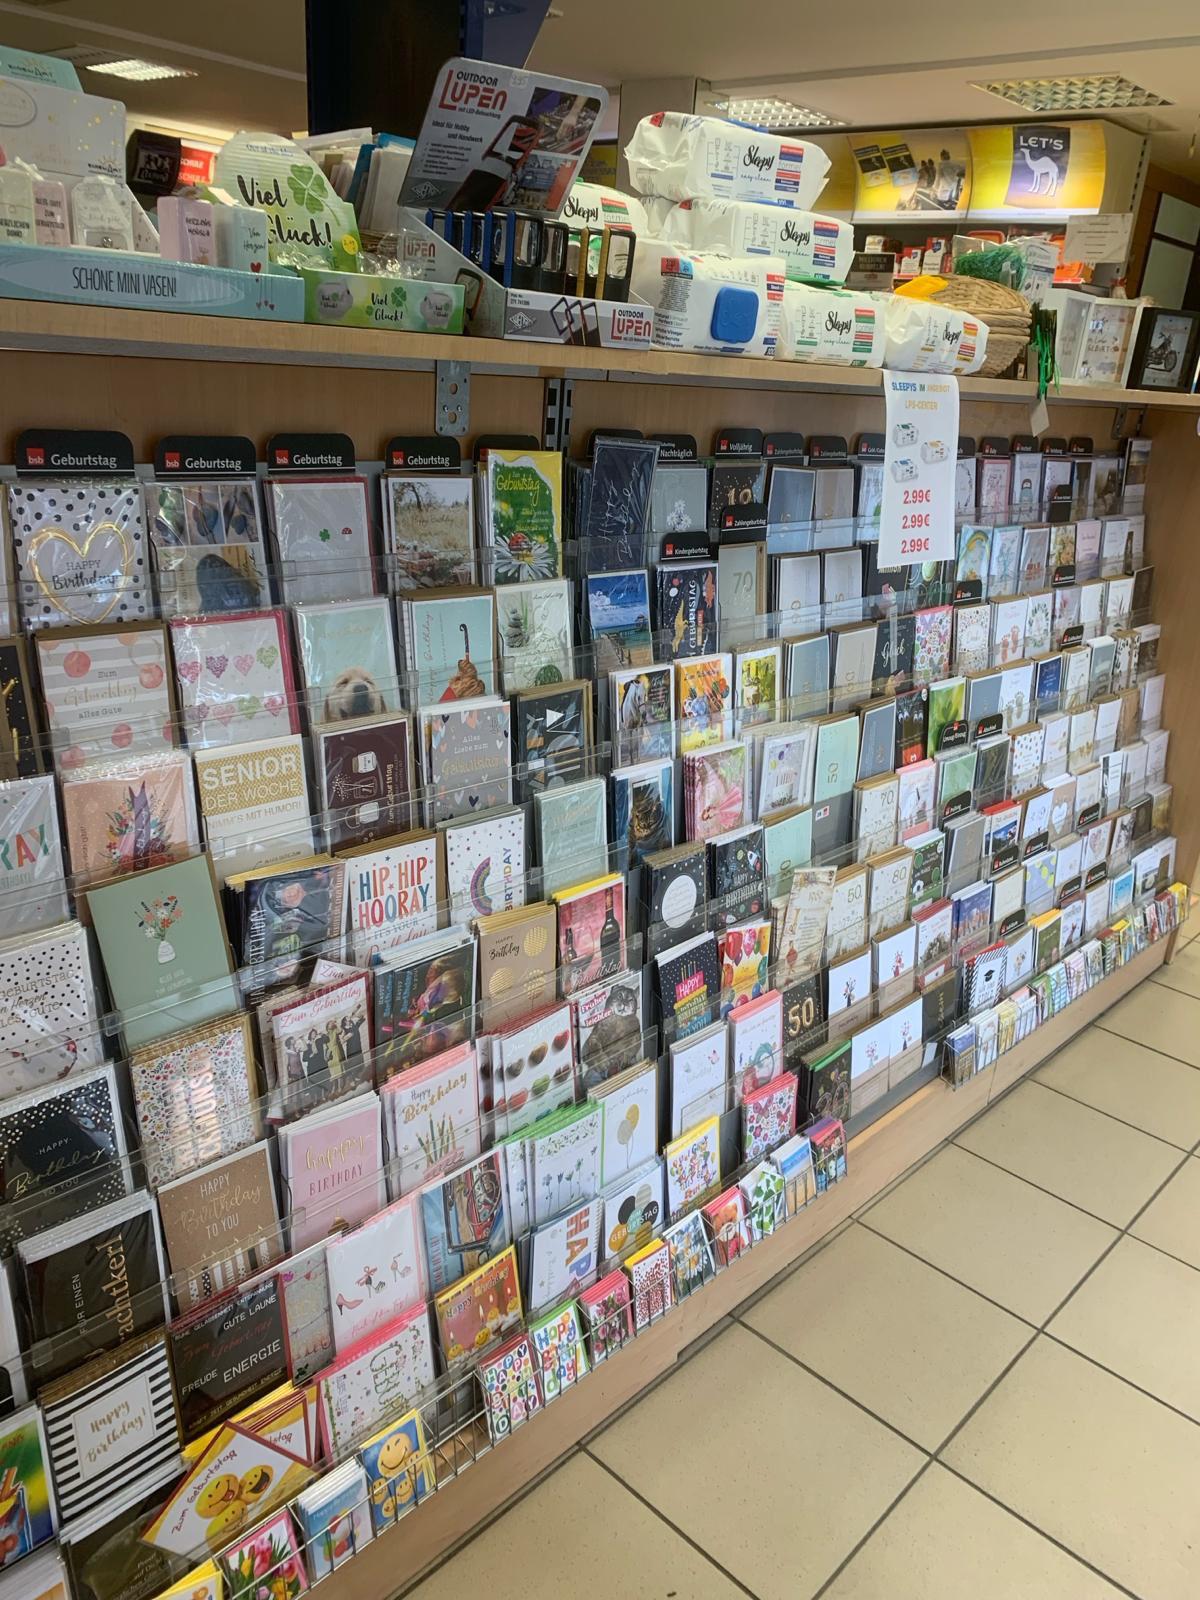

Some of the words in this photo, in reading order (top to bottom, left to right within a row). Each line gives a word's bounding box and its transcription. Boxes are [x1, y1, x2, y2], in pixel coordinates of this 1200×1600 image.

[438, 69, 508, 112] LUPEN
[456, 71, 499, 87] OUTDOOR
[1019, 135, 1064, 150] LET'S
[743, 145, 775, 172] Sleepy
[237, 175, 287, 207] Viel
[564, 196, 599, 222] Sleepy
[780, 220, 810, 246] Sleepy
[117, 271, 140, 294] MINI
[143, 273, 177, 297] VASEN!
[371, 292, 388, 306] Viel
[611, 309, 651, 340] LUPEN
[617, 310, 644, 318] OUTDOOR
[825, 311, 852, 336] Sleepy
[892, 381, 916, 392] SLEEPYS
[28, 456, 44, 465] bsb
[51, 454, 117, 468] Geburtstag
[166, 459, 179, 468] bsb
[185, 458, 242, 471] Geburtstag
[293, 454, 342, 466] Geburtstag
[408, 455, 450, 467] Geburtstag
[497, 473, 539, 506] Geburtstag
[903, 489, 931, 505] 2.99€
[902, 513, 930, 529] 2.99€
[901, 538, 930, 554] 2.99€
[66, 560, 101, 571] HAPPY
[688, 579, 698, 648] GEBURTSTAG
[454, 744, 474, 753] Liebe
[463, 735, 480, 743] Alles
[203, 754, 297, 789] SENIOR
[205, 793, 238, 810] DER
[244, 780, 300, 801] WOCHE
[245, 808, 263, 821] MIT
[359, 862, 390, 902] HIP
[398, 856, 428, 890] HIP
[503, 848, 513, 911] BIRTHDAY
[358, 883, 430, 929] HOORAY
[726, 883, 759, 908] BIRTHDAY
[250, 907, 266, 964] BIRTHDAY
[488, 944, 520, 961] Birthday
[320, 964, 344, 978] Zum
[679, 975, 700, 997] HAPPY
[280, 1012, 307, 1028] Zum
[312, 986, 361, 1018] Geburtstag
[788, 997, 814, 1036] 50
[402, 1072, 467, 1123] Birthday
[410, 1088, 431, 1101] Happy
[39, 1137, 72, 1155] HAPPY
[305, 1135, 367, 1170] happy
[6, 1147, 106, 1200] Birthday
[200, 1172, 230, 1197] HAPPY
[309, 1164, 364, 1196] BIRTHDAY
[174, 1184, 262, 1233] Birthday
[206, 1223, 218, 1240] TO
[221, 1212, 239, 1232] YOU
[71, 1273, 85, 1308] EINEN
[96, 1233, 134, 1342] achtkerl
[446, 1295, 473, 1318] Happy
[474, 1266, 510, 1297] Birthday
[223, 1313, 246, 1331] GUTE
[249, 1294, 277, 1315] LAUNE
[182, 1369, 218, 1396] FREUDE
[223, 1339, 281, 1383] ENERGIE
[90, 1401, 130, 1433] Happy
[86, 1407, 147, 1463] Birthday!
[171, 1508, 189, 1535] Zum
[187, 1449, 237, 1504] Geburtstag
